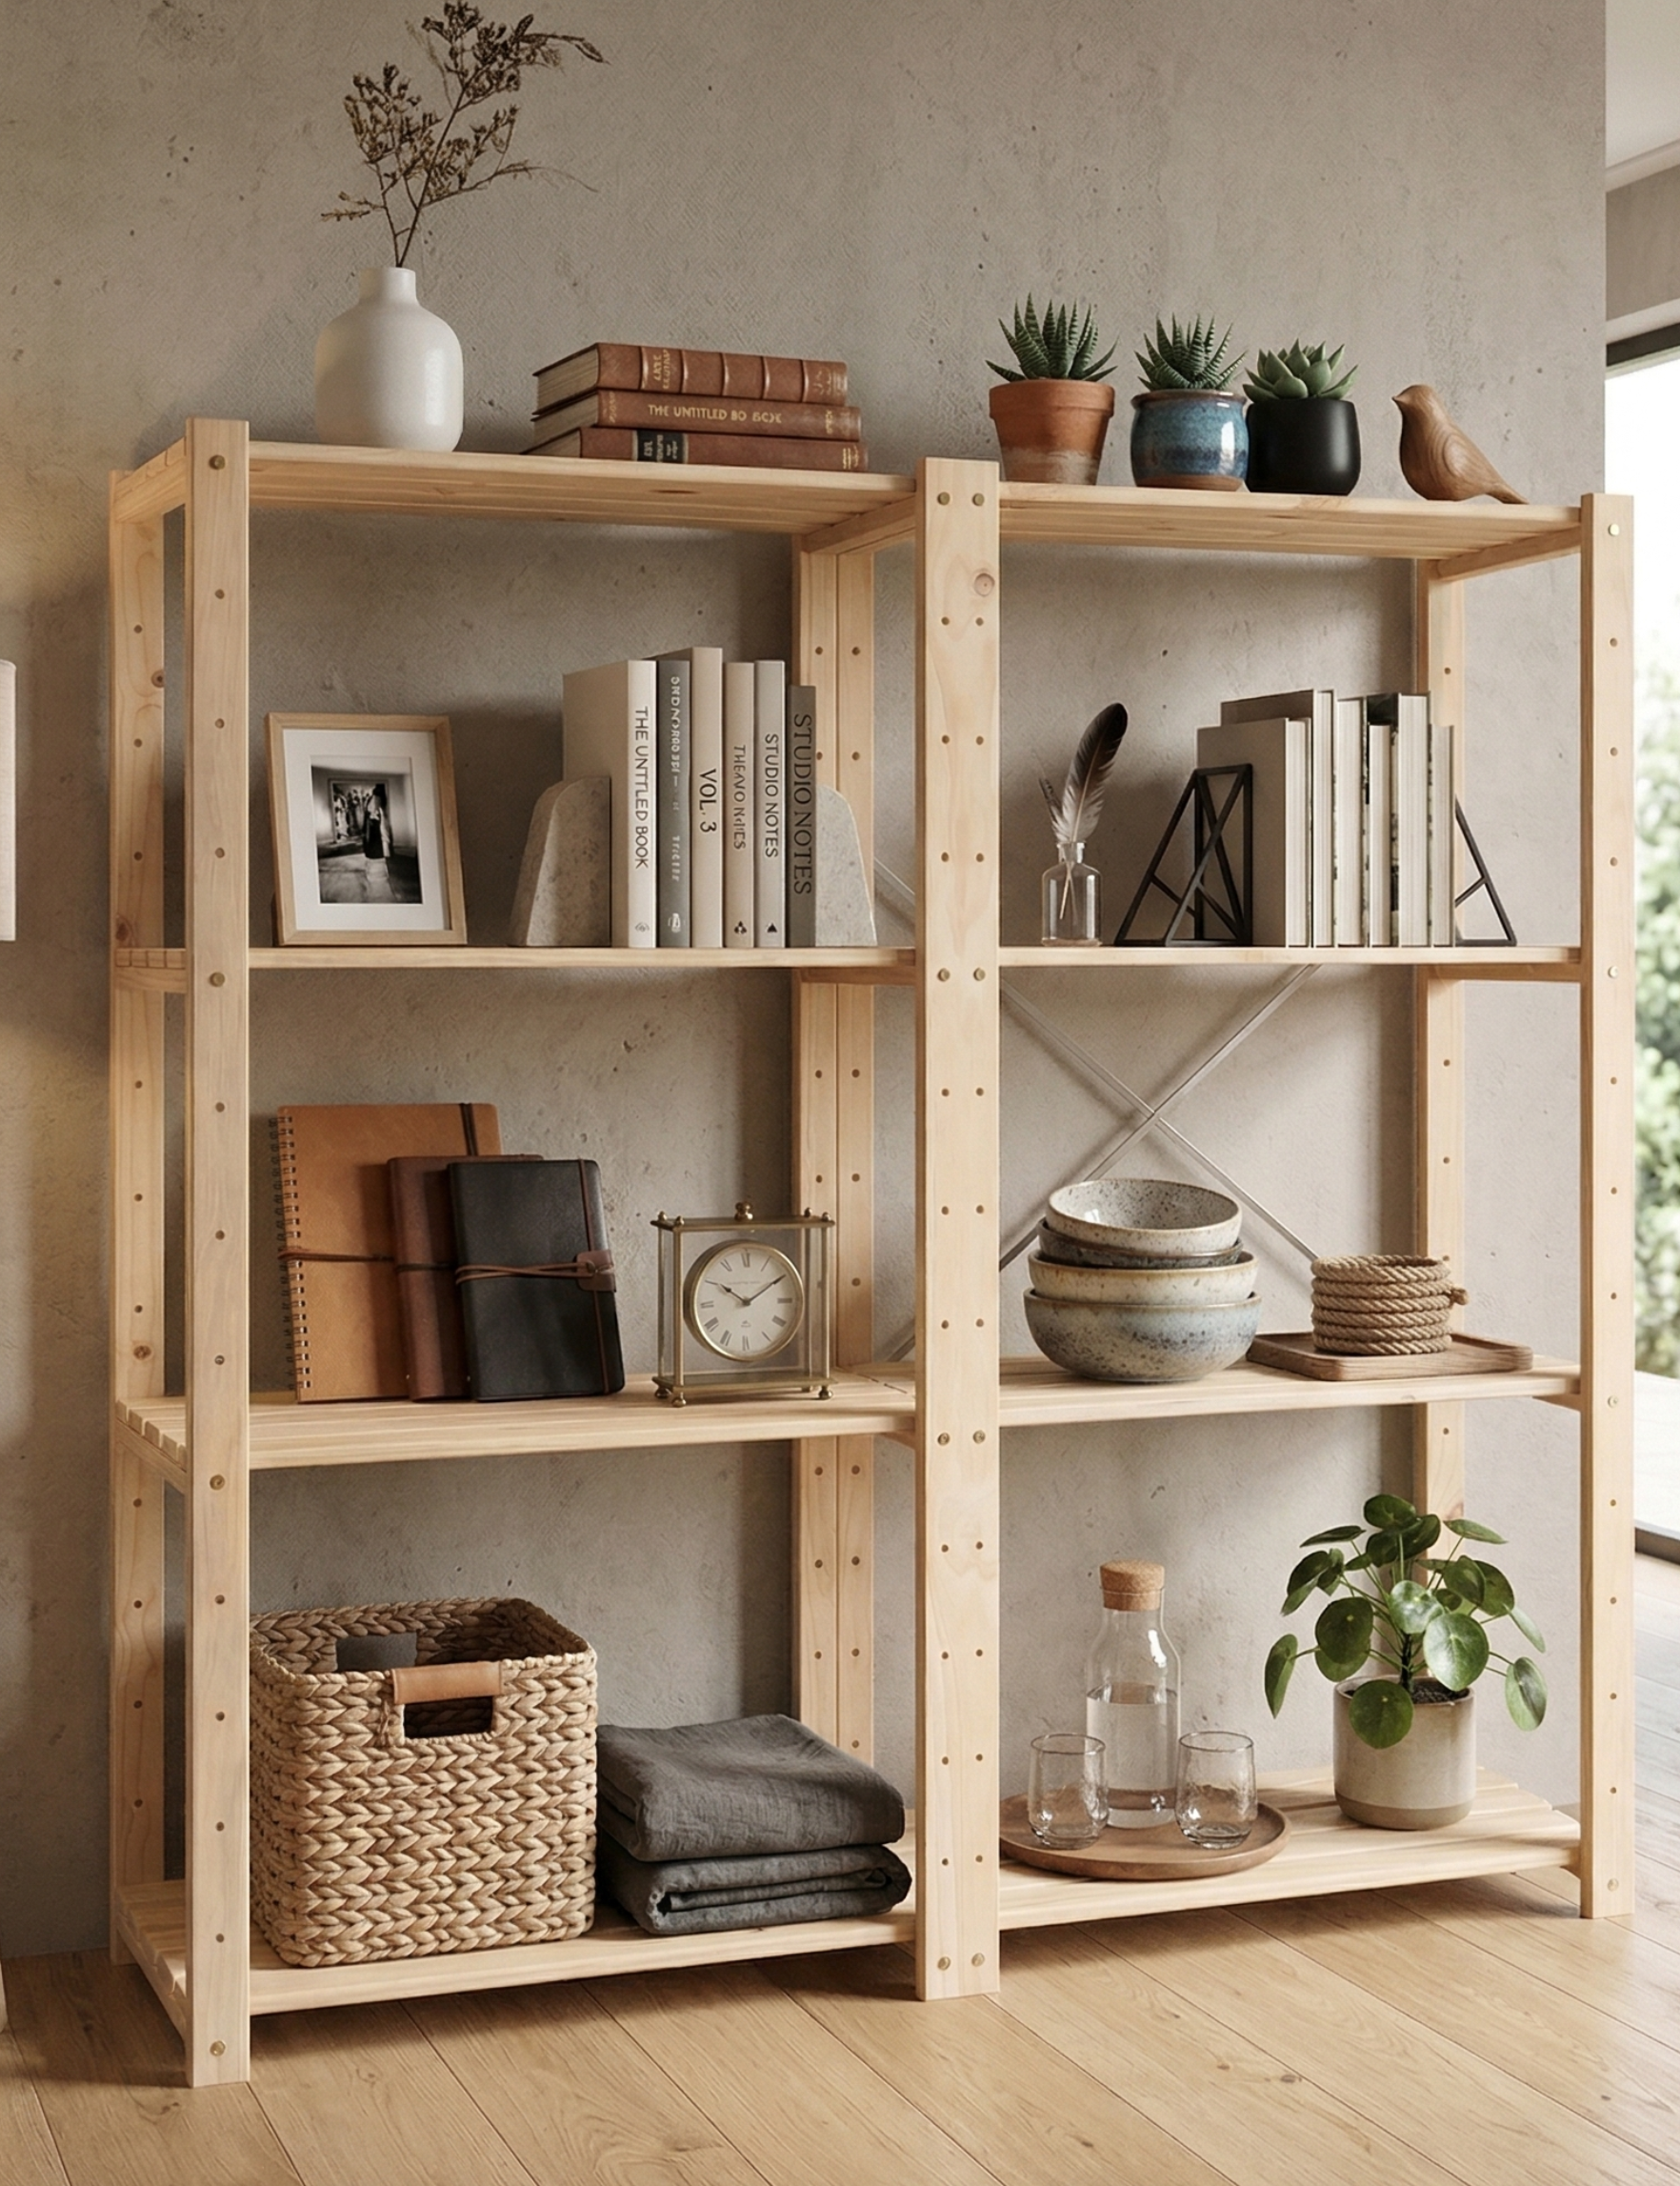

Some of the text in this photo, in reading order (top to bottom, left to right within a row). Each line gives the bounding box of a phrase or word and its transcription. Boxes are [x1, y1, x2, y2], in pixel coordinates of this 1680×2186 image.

[648, 404, 670, 416] THE
[634, 706, 649, 741] THE
[765, 733, 779, 858] STUDIO NOTES
[793, 713, 813, 894] STUDIO NOTES
[699, 821, 717, 833] 3
[634, 826, 649, 869] BOOK
